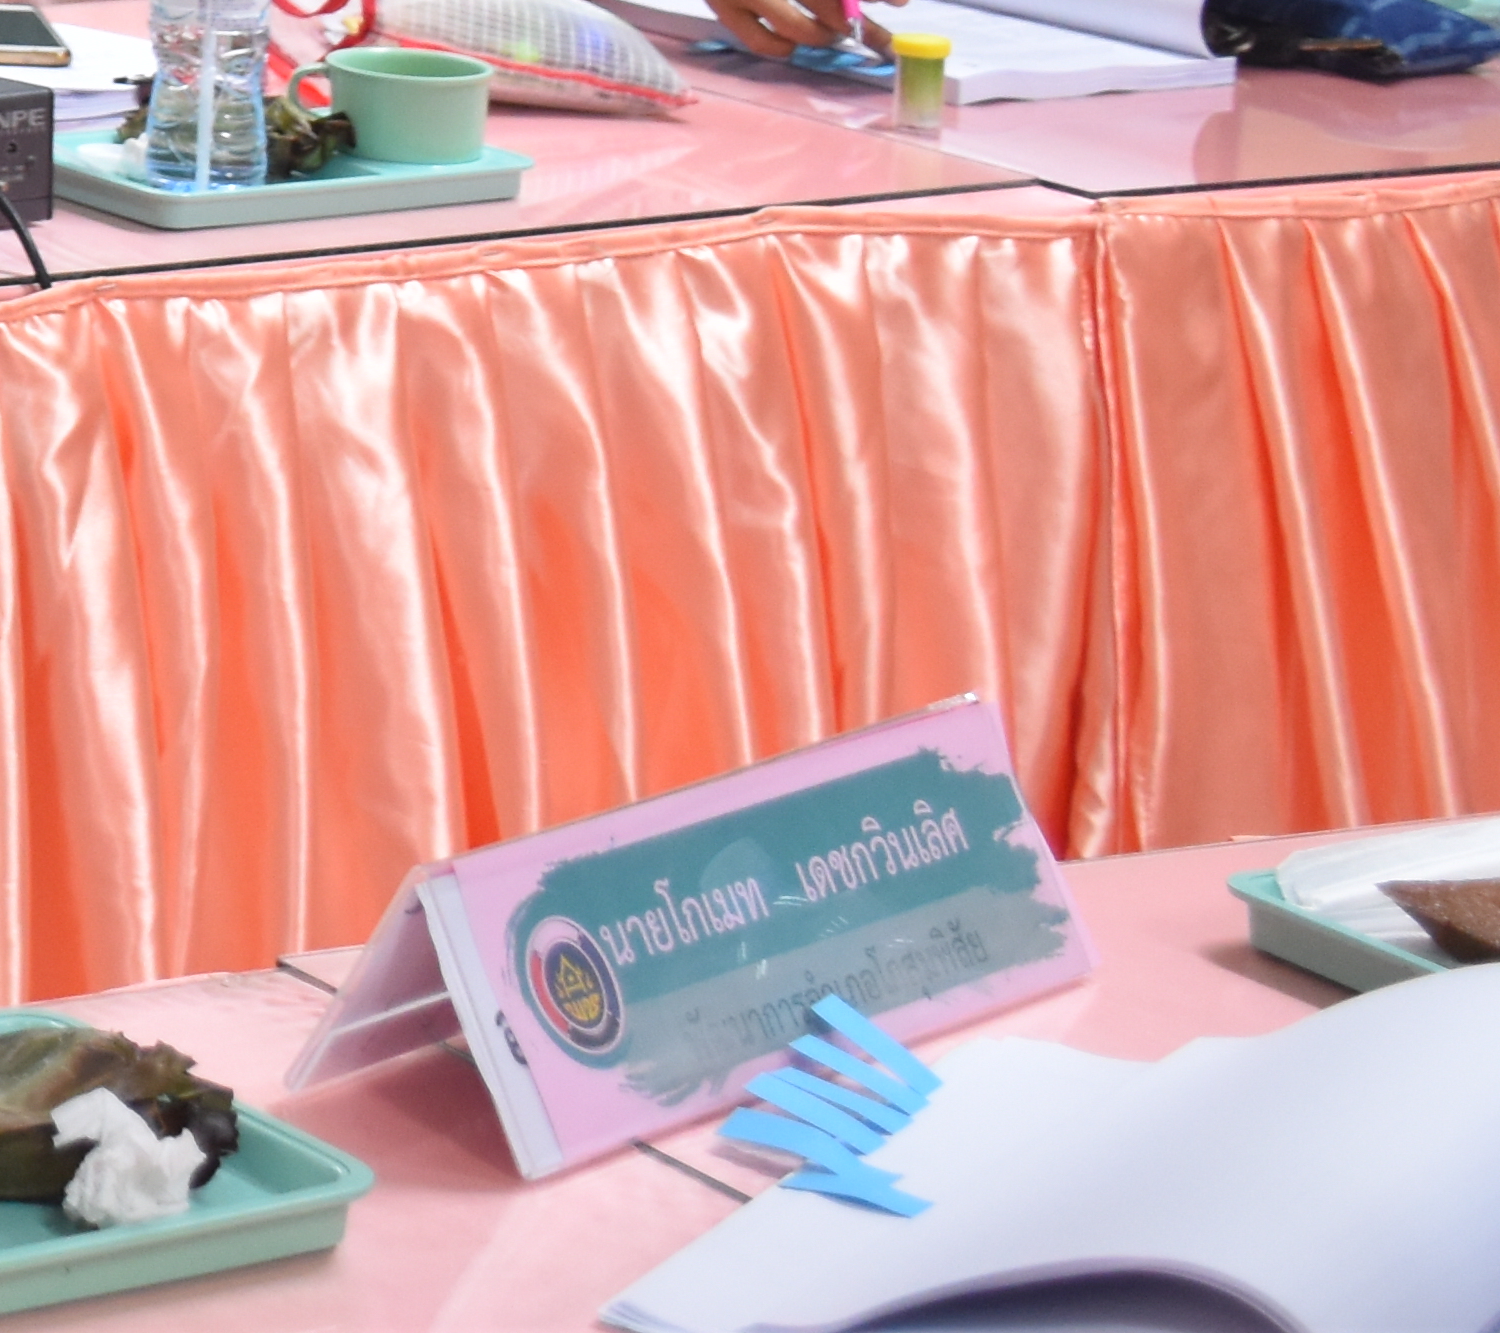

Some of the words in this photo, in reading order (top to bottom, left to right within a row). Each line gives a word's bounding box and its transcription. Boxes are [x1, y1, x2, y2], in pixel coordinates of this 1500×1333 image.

[600, 877, 769, 966] นายโกเมท
[795, 799, 970, 902] เดชกวินเลิศ
[684, 918, 989, 1055] พันาการอำเภอโกสุมพิสัย
